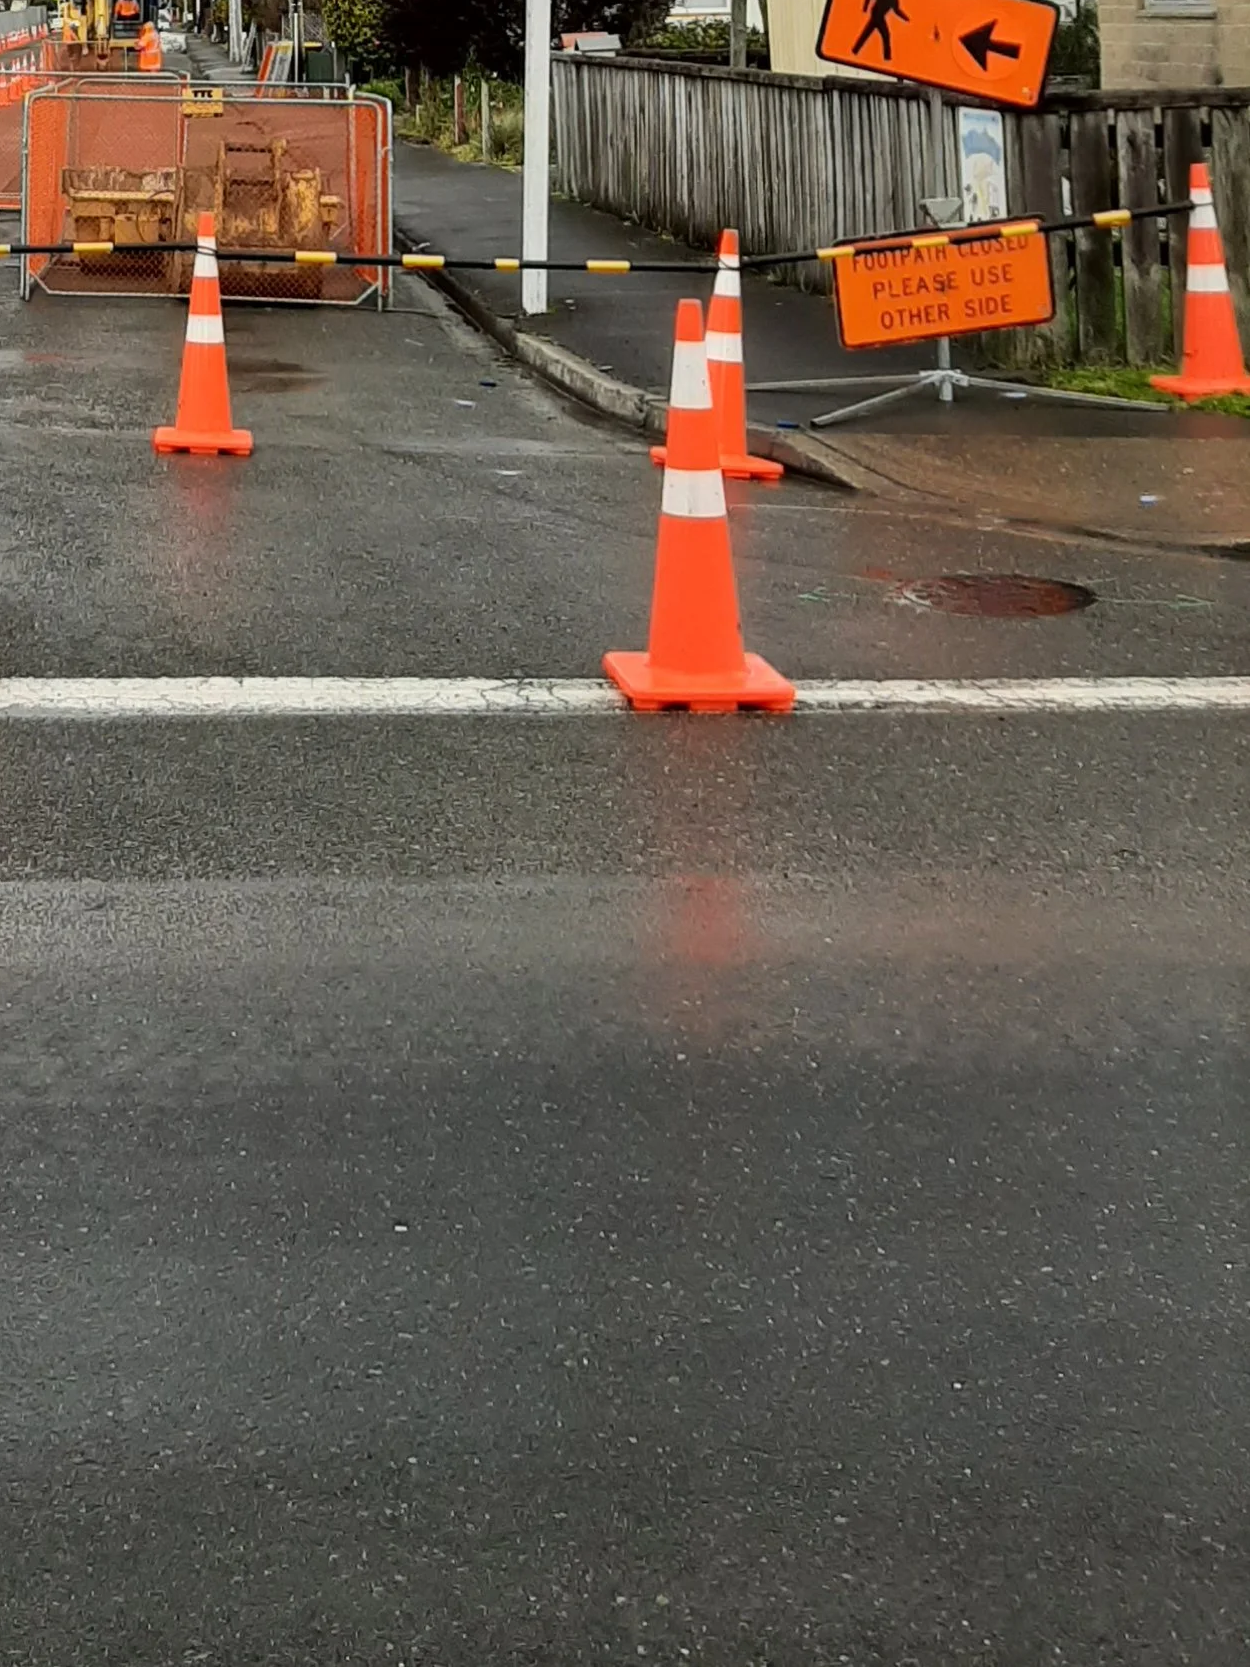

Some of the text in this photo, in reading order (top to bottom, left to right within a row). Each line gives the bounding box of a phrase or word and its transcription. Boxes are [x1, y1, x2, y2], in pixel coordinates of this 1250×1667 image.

[873, 263, 1014, 299] PLEASE USE
[881, 294, 1013, 330] OTHER SIDE
